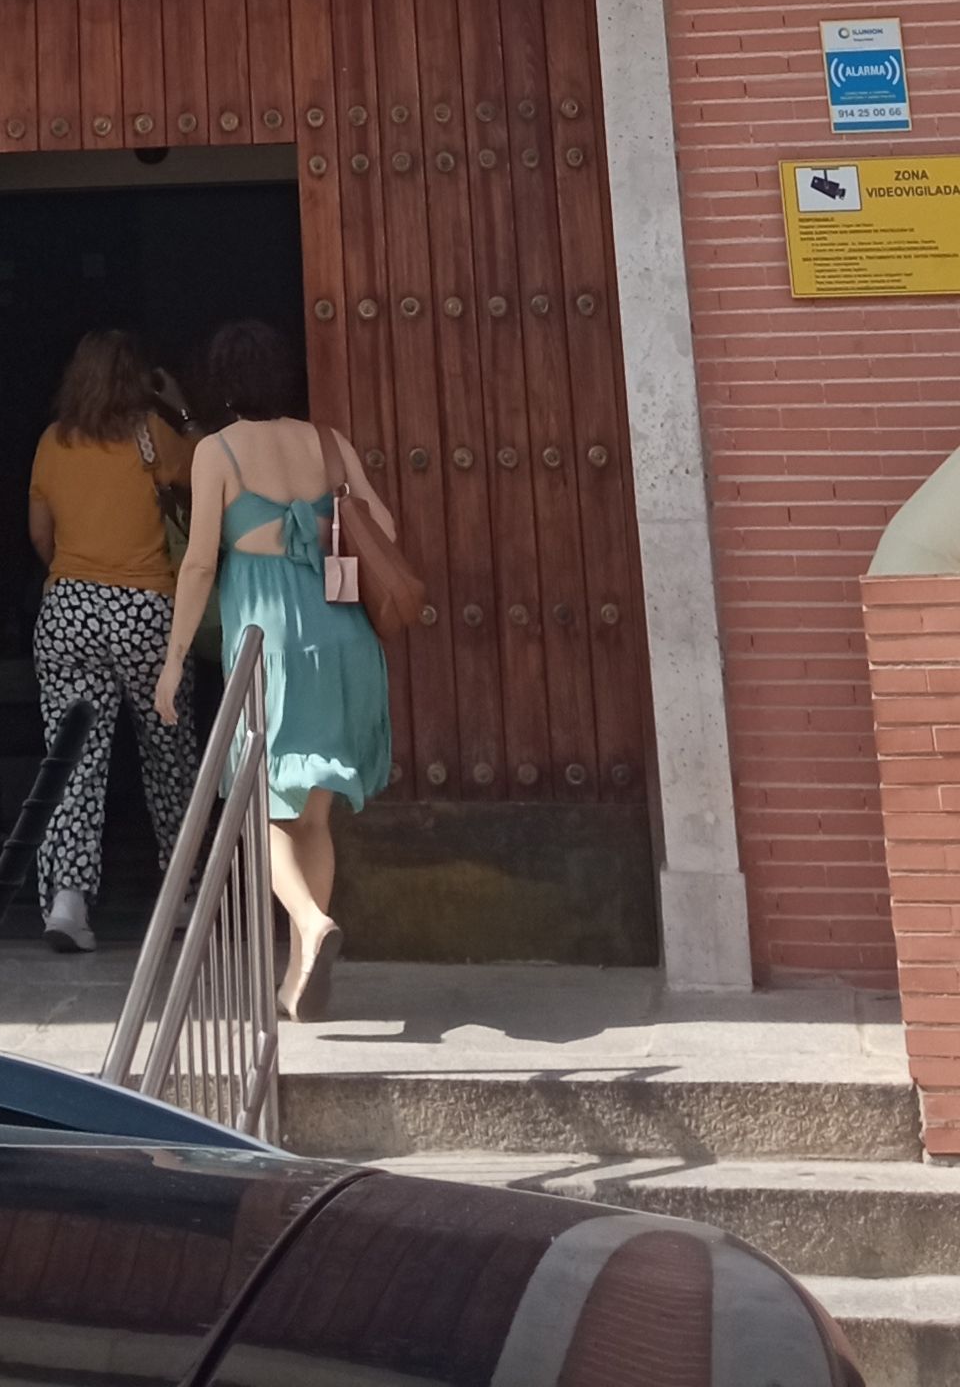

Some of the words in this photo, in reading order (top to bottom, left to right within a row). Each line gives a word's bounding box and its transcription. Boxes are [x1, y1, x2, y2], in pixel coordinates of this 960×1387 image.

[845, 64, 886, 76] ALARMA
[838, 109, 855, 118] 914
[858, 108, 870, 117] 25
[873, 108, 886, 116] 00
[894, 170, 929, 181] ZONA
[866, 185, 960, 198] VIDEOVIGILADA
